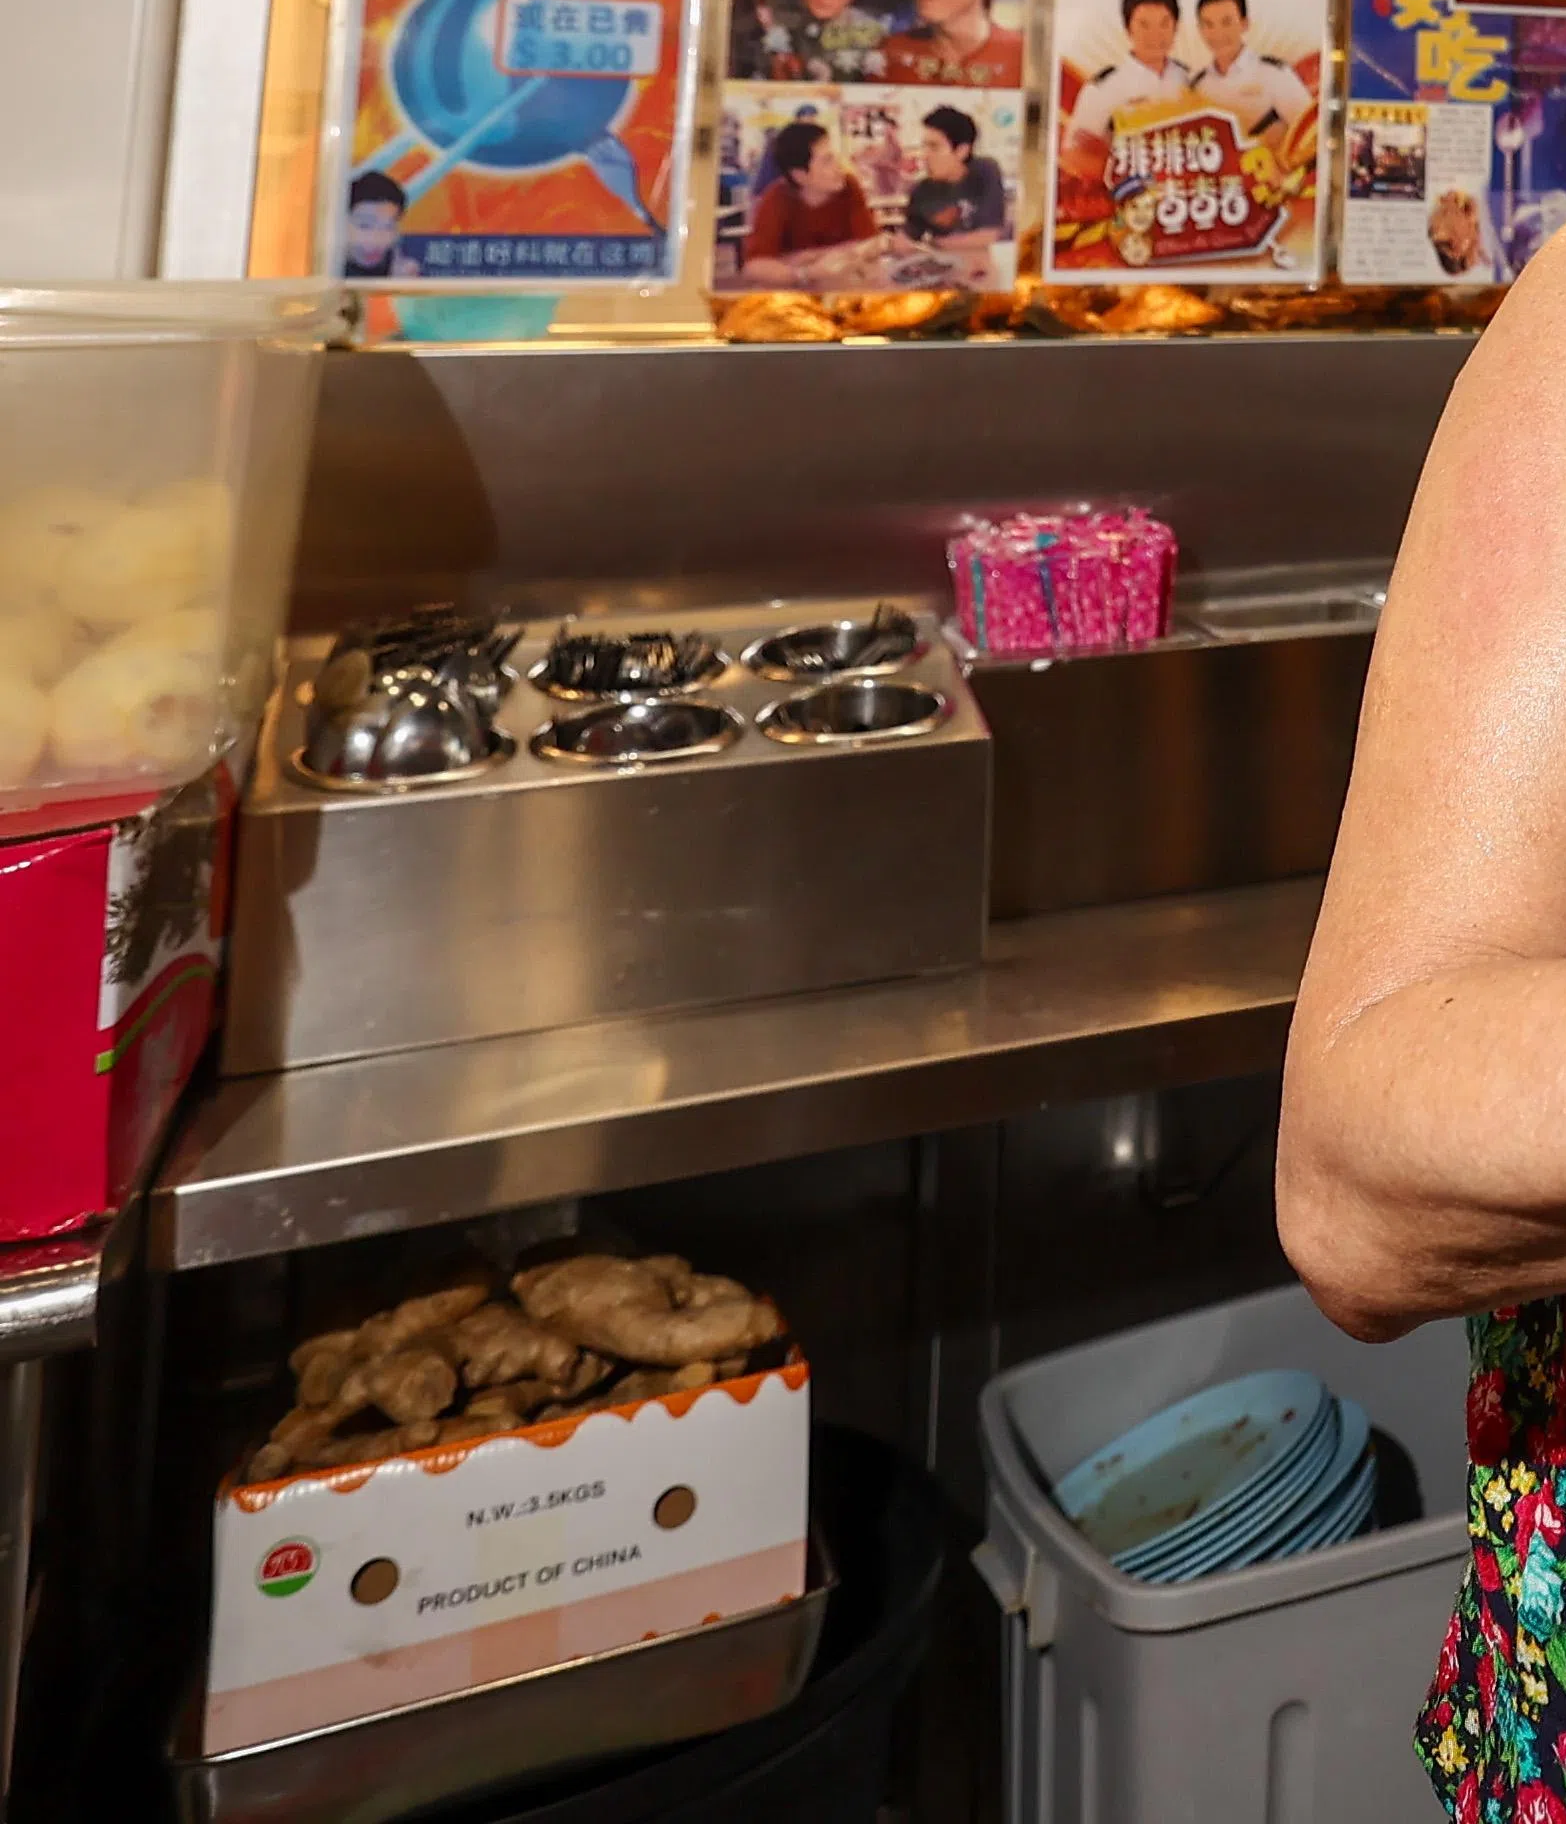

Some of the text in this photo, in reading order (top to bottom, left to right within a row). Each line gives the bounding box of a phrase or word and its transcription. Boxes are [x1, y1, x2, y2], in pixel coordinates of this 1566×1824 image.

[417, 1543, 642, 1616] PRODUCT OF CHINA
